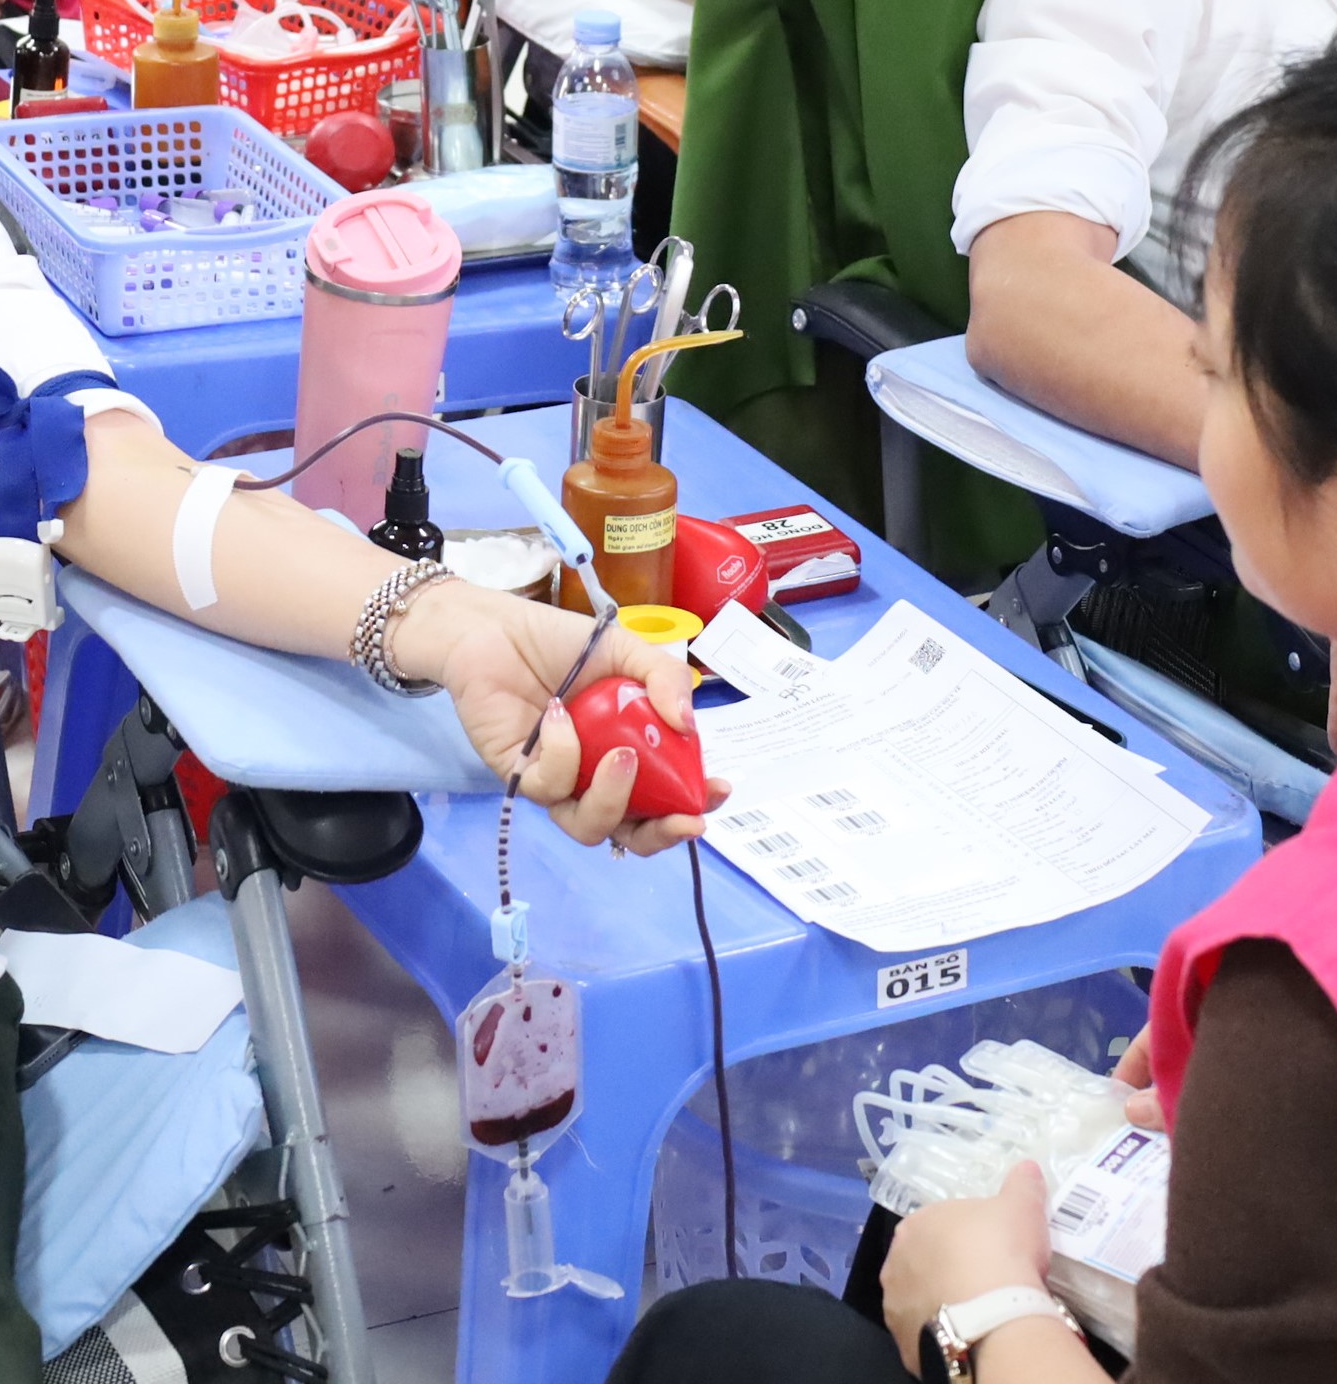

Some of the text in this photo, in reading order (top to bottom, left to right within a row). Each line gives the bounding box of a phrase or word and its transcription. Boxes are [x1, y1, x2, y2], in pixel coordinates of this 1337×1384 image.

[762, 519, 793, 531] 28
[720, 559, 743, 580] Roche
[889, 951, 960, 977] BÀN SỐ
[886, 964, 961, 999] 015
